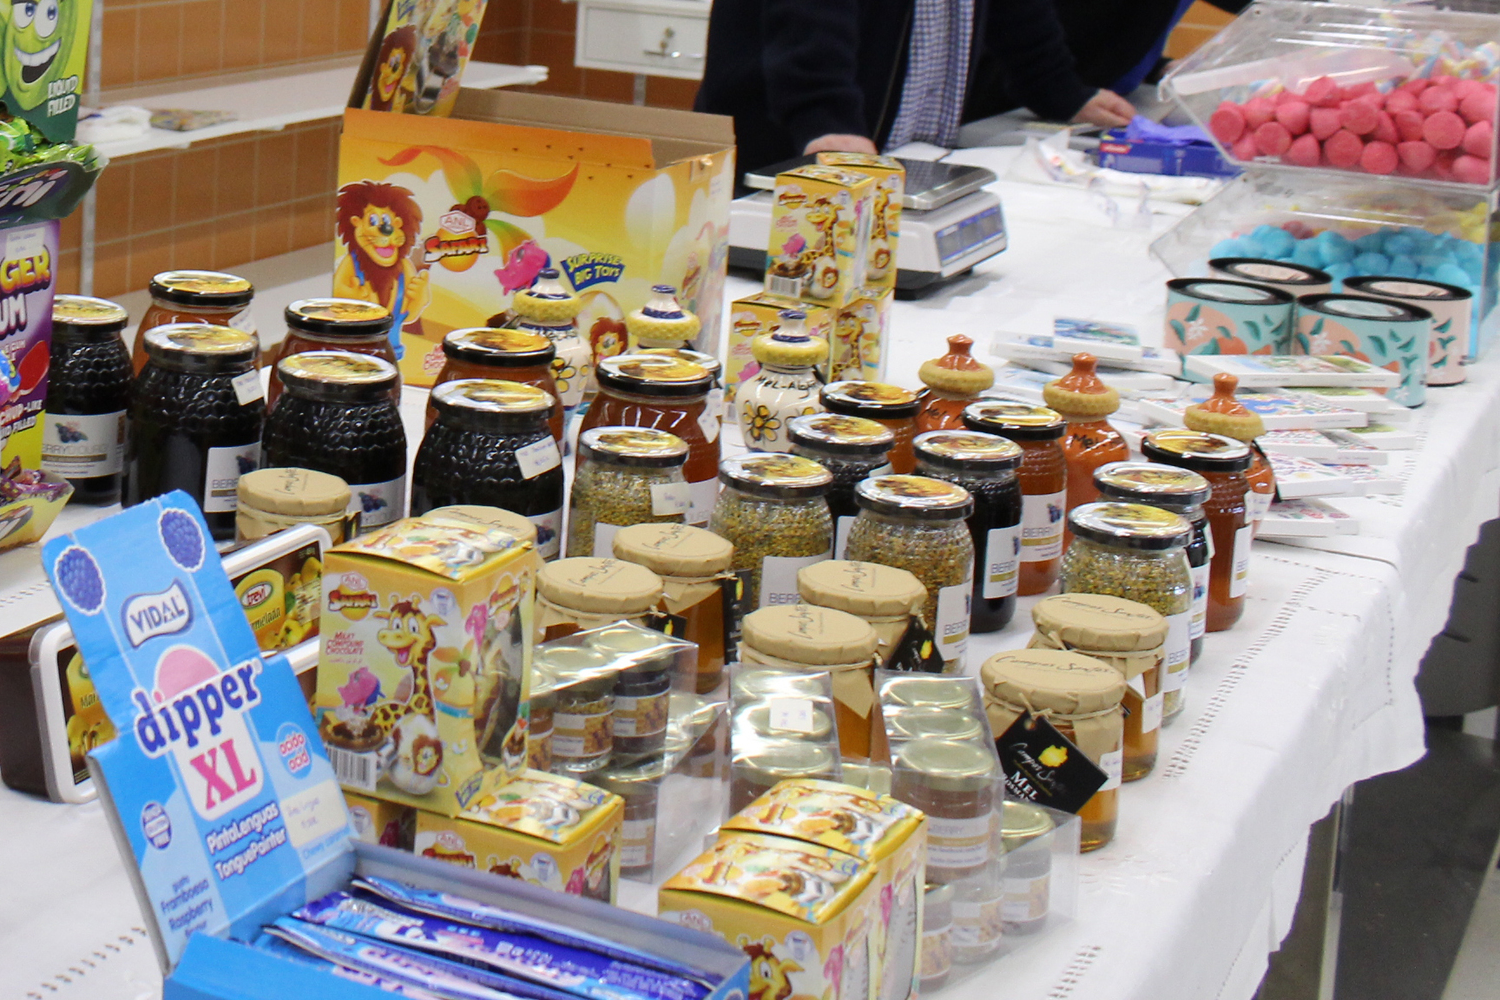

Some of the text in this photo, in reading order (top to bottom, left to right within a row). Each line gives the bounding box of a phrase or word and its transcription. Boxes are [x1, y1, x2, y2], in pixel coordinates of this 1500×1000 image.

[565, 251, 623, 275] SURPRISE
[573, 269, 592, 286] BIG
[129, 595, 187, 634] VIDAL
[133, 662, 259, 754] dipper
[189, 737, 258, 811] XL
[1009, 770, 1040, 802] MEL
[213, 826, 288, 881] TonguePainter
